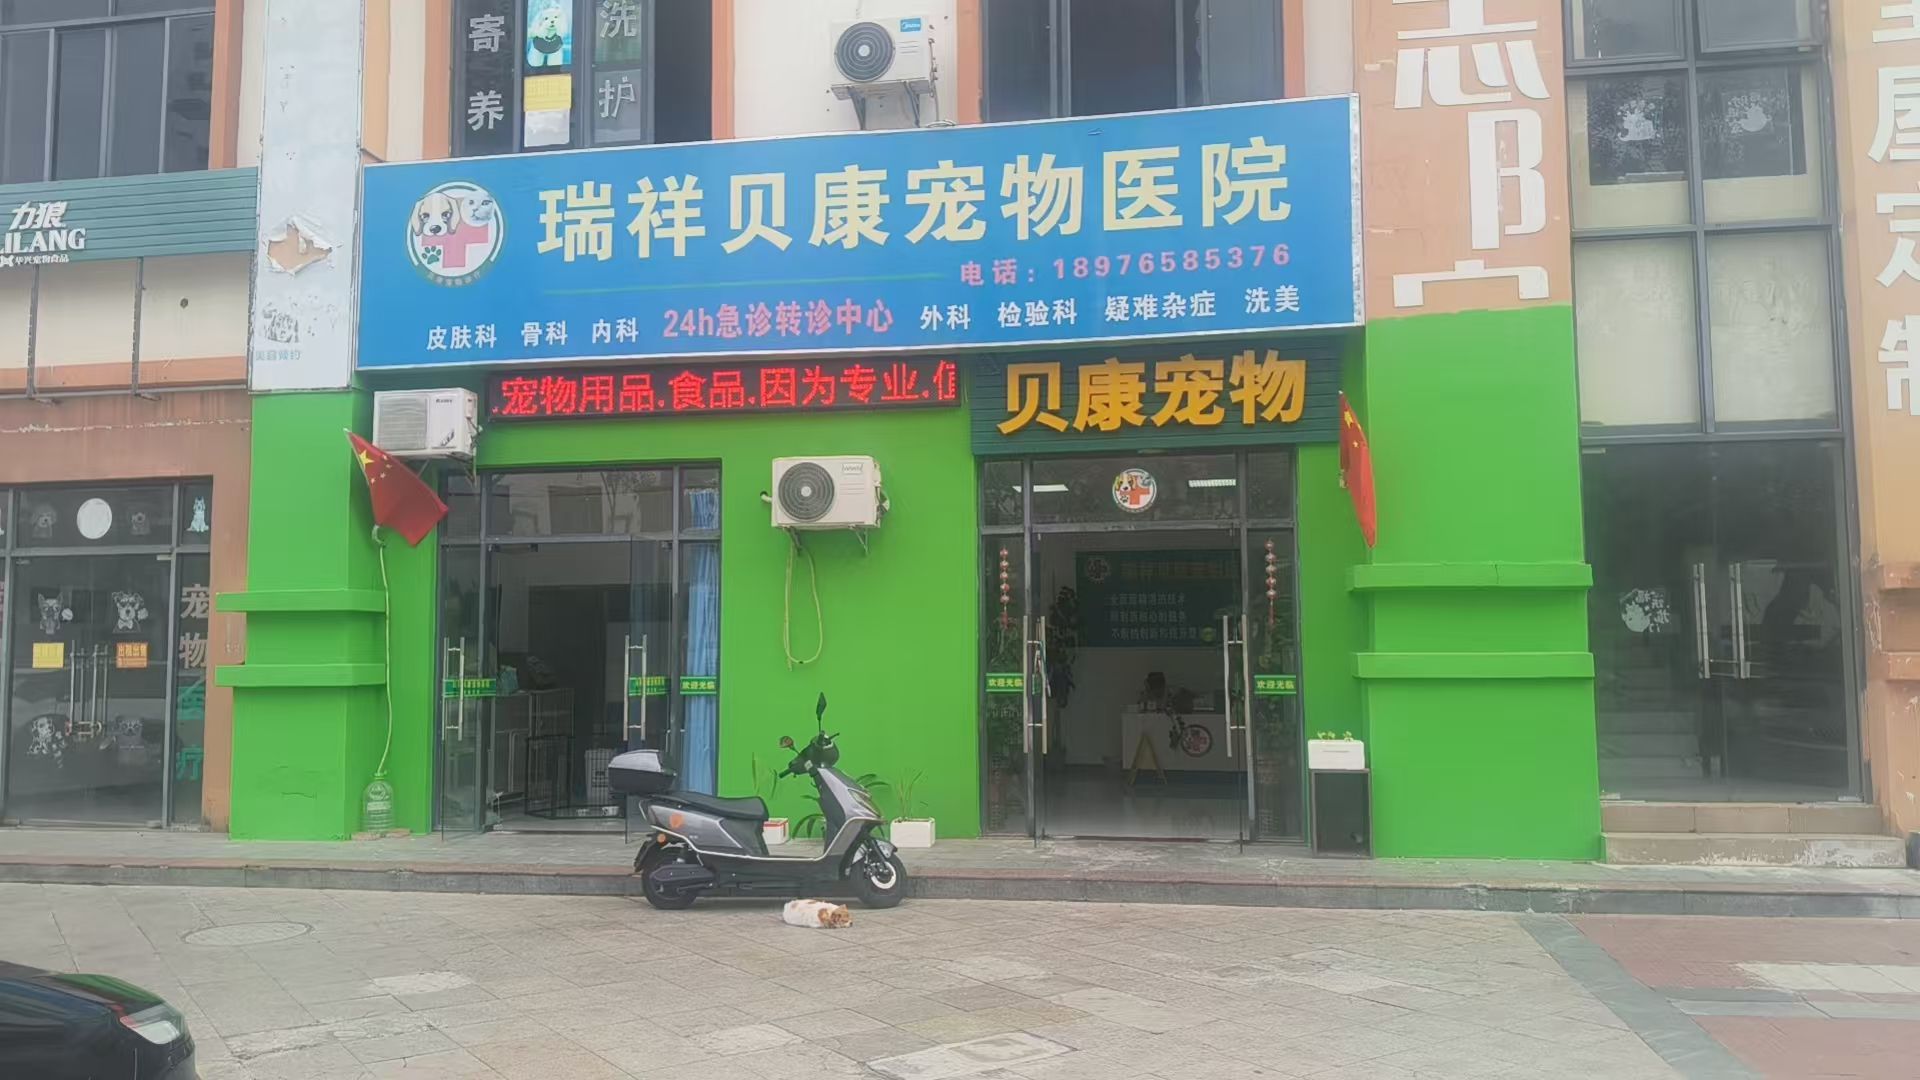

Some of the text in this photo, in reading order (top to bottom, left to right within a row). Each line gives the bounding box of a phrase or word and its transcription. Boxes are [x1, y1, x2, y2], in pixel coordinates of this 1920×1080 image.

[467, 14, 505, 131] 寄养
[598, 0, 637, 118] 洗护
[0, 227, 86, 254] ILANG
[536, 136, 1292, 262] 瑞祥贝康宠物医院
[426, 285, 1301, 352] 皮肤科 骨科 内科 24h急诊转诊中心 外科 检验科 疑难杂症 洗美
[996, 348, 1307, 436] 贝康宠物
